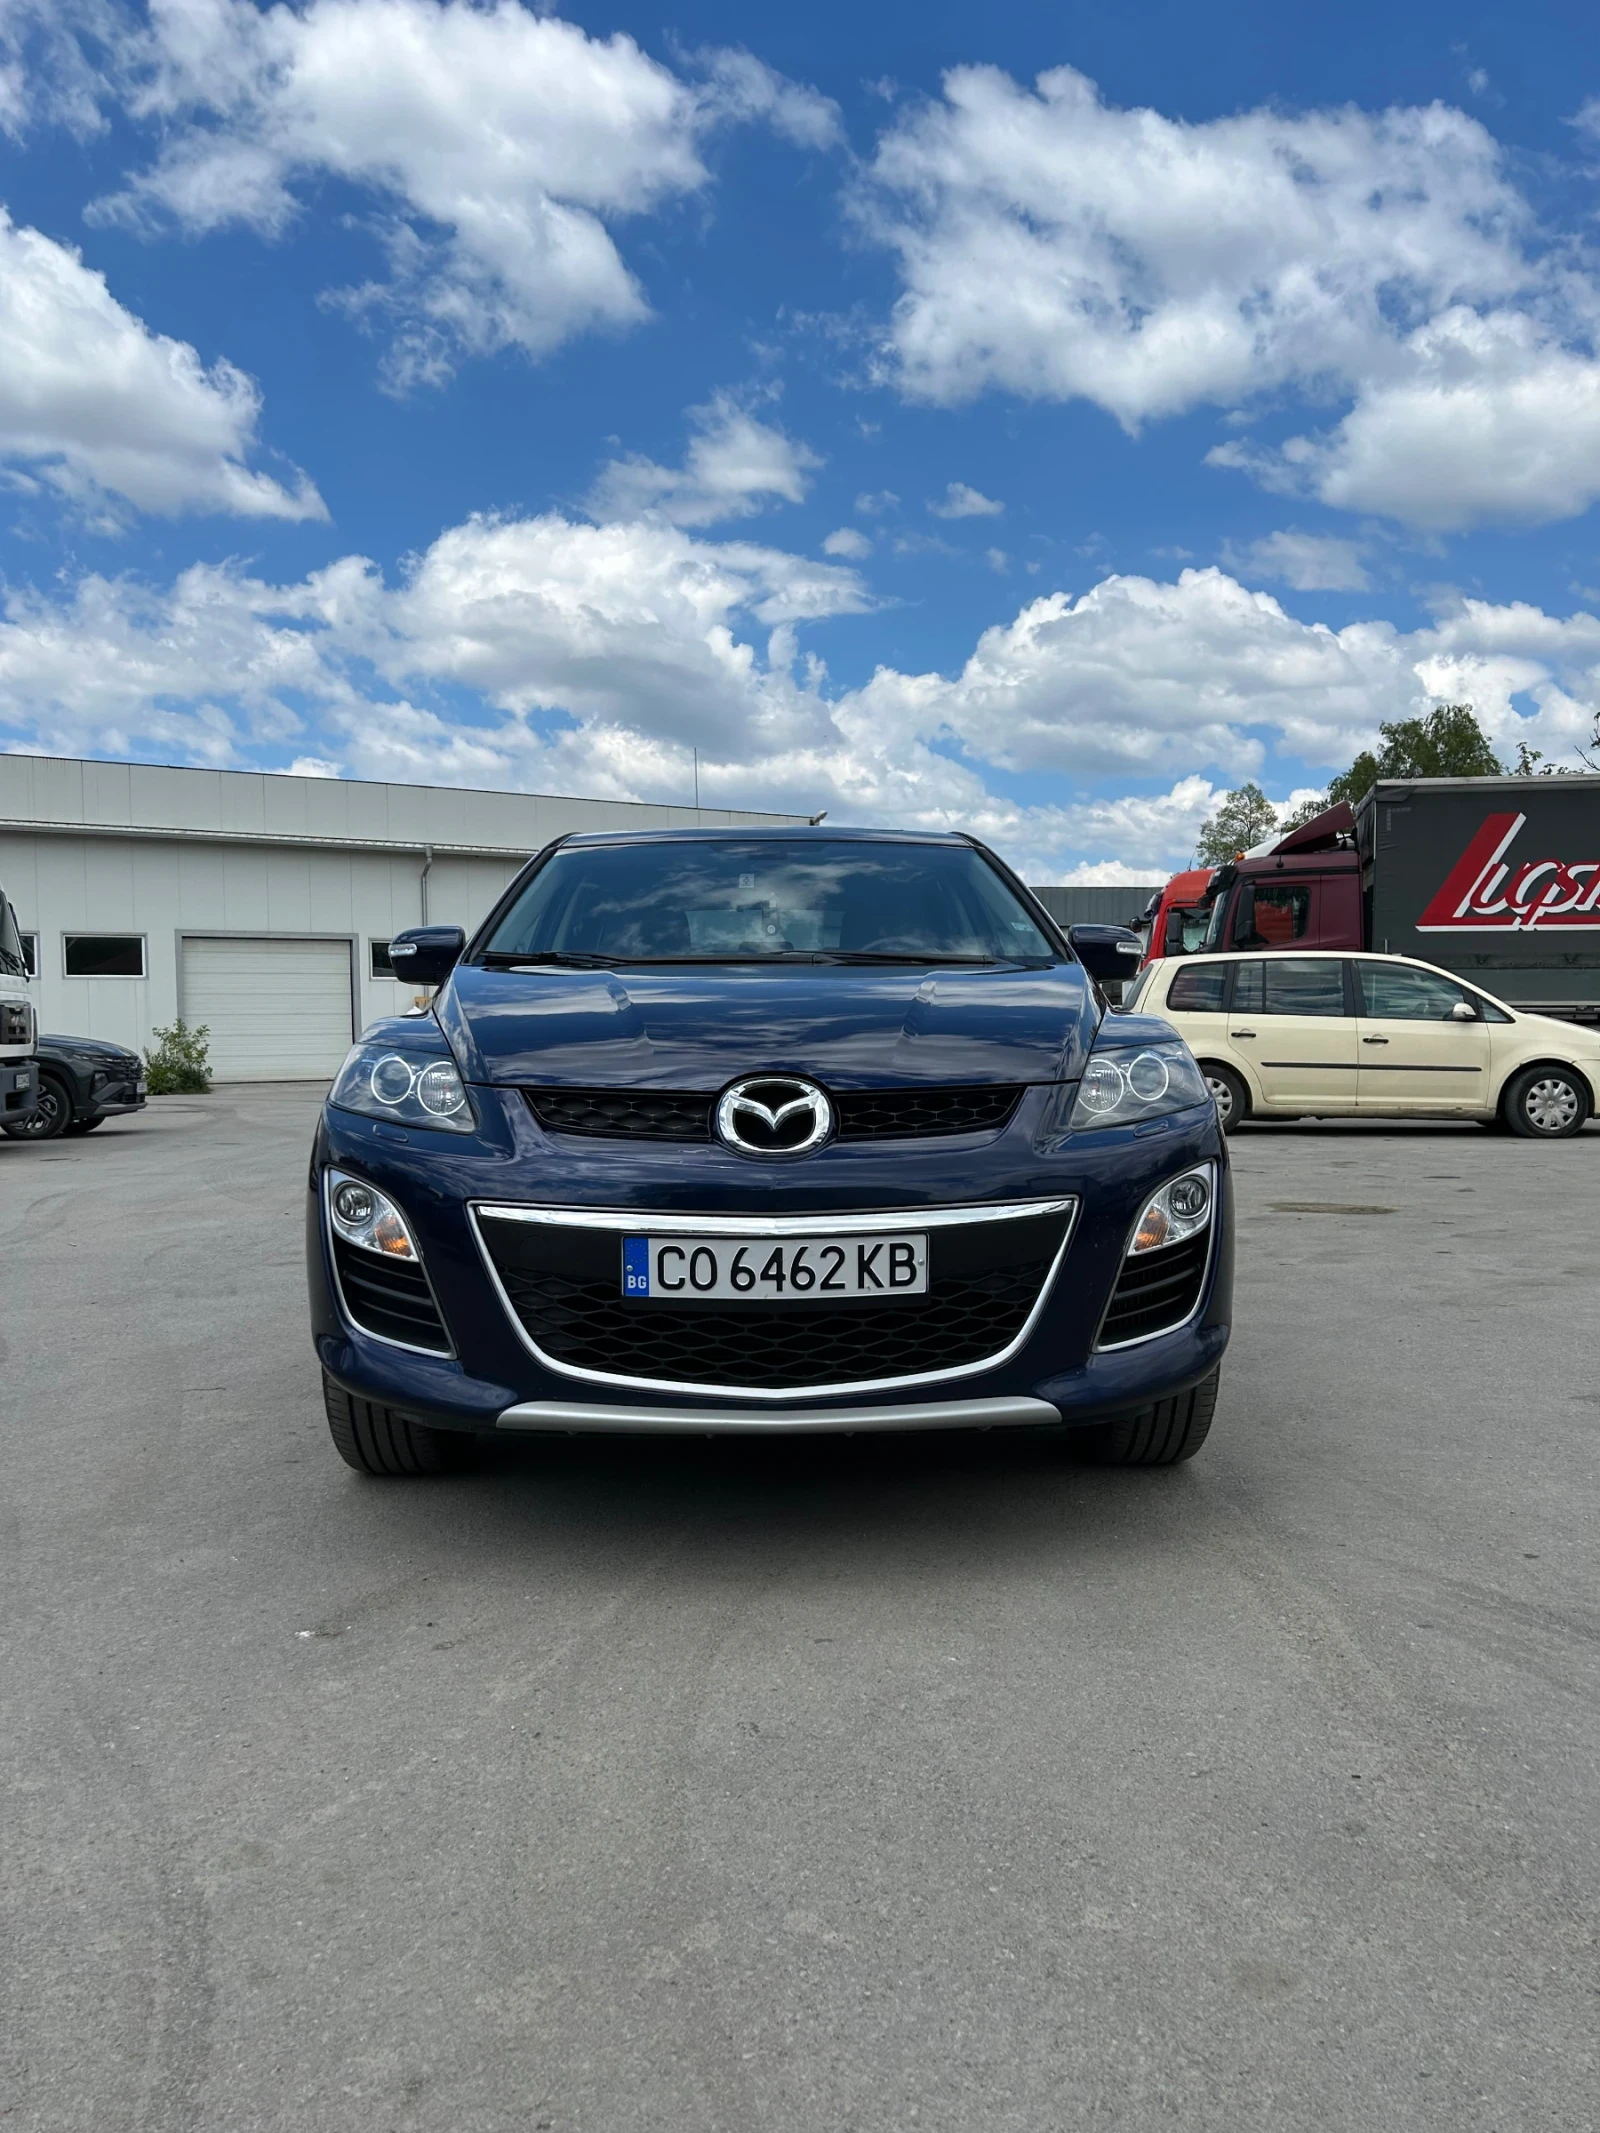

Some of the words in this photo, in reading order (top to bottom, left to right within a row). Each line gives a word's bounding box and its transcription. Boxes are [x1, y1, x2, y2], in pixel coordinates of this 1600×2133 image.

[627, 1275, 647, 1289] BG
[657, 1245, 718, 1291] CO
[730, 1246, 846, 1292] 6462
[857, 1242, 917, 1290] KB
